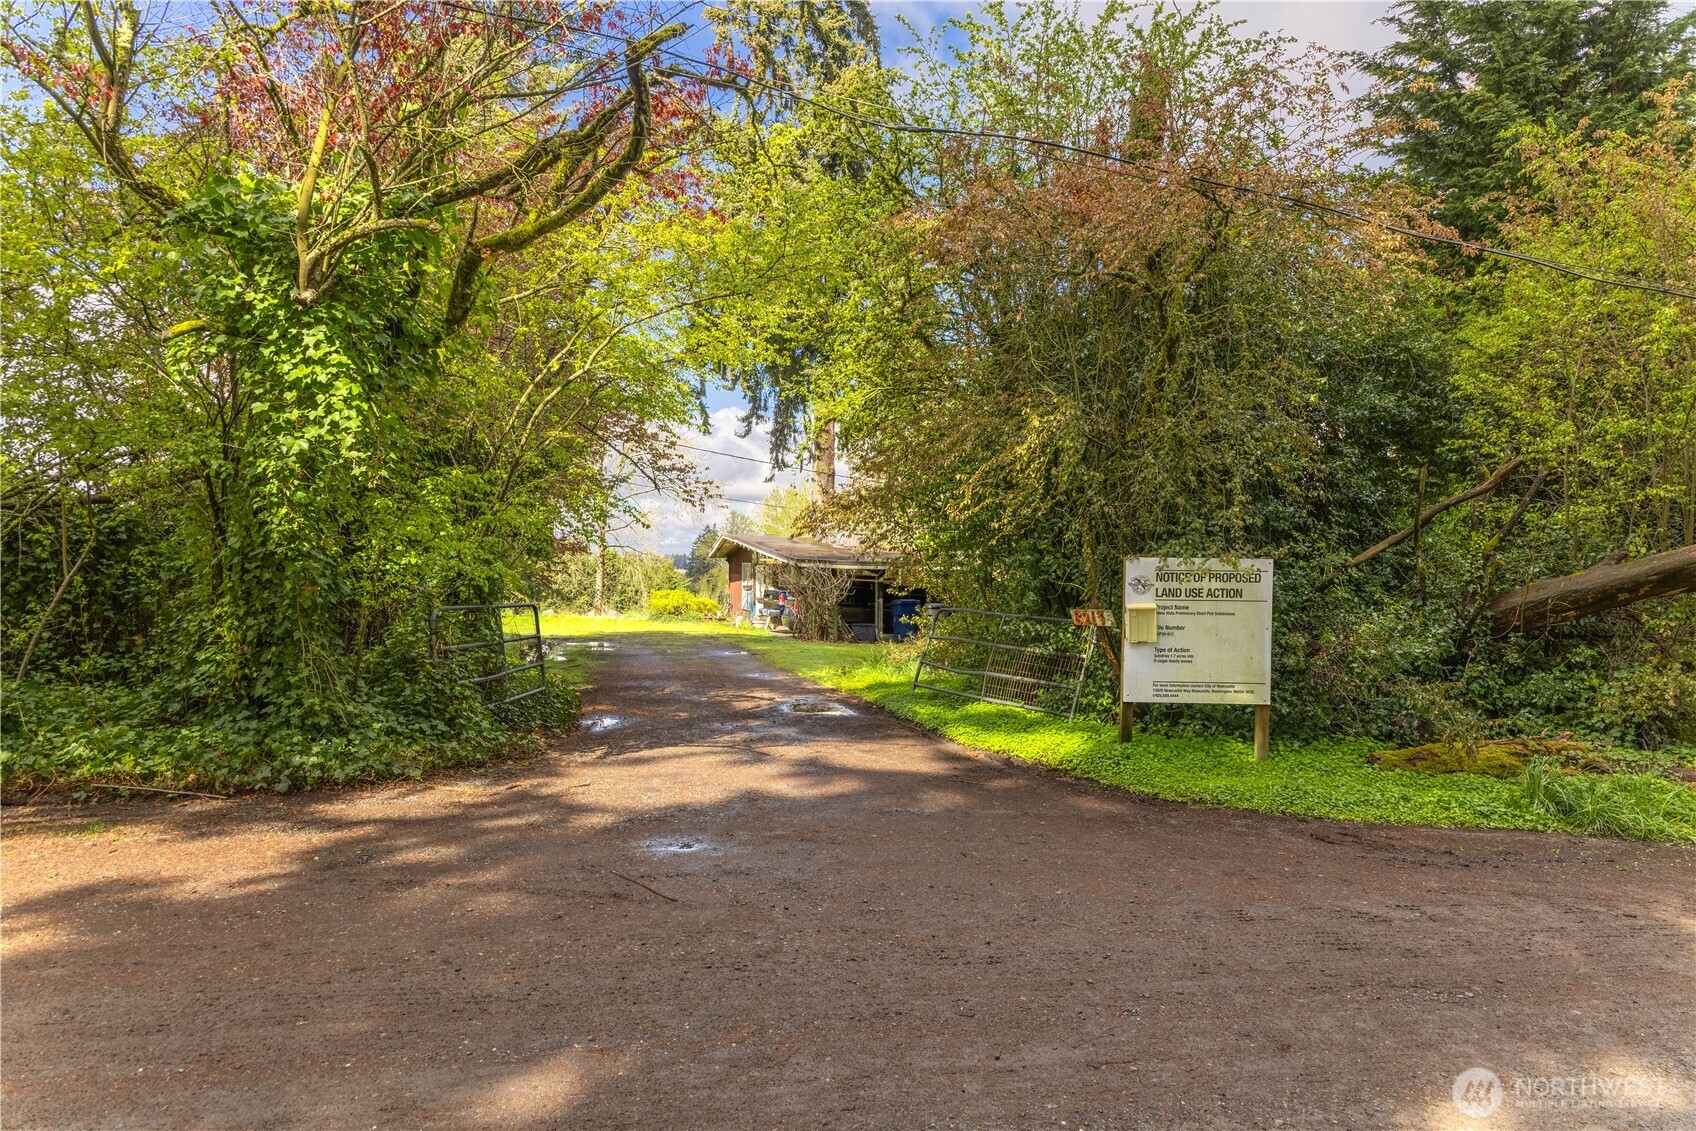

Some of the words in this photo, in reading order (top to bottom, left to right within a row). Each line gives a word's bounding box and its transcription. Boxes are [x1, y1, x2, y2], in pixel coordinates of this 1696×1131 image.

[1156, 572, 1191, 582] NOTICE
[1194, 572, 1205, 582] OF
[1208, 572, 1262, 583] PROPOSED
[1156, 588, 1182, 598] LAND
[1185, 588, 1204, 598] USE
[1206, 588, 1243, 598] ACTION
